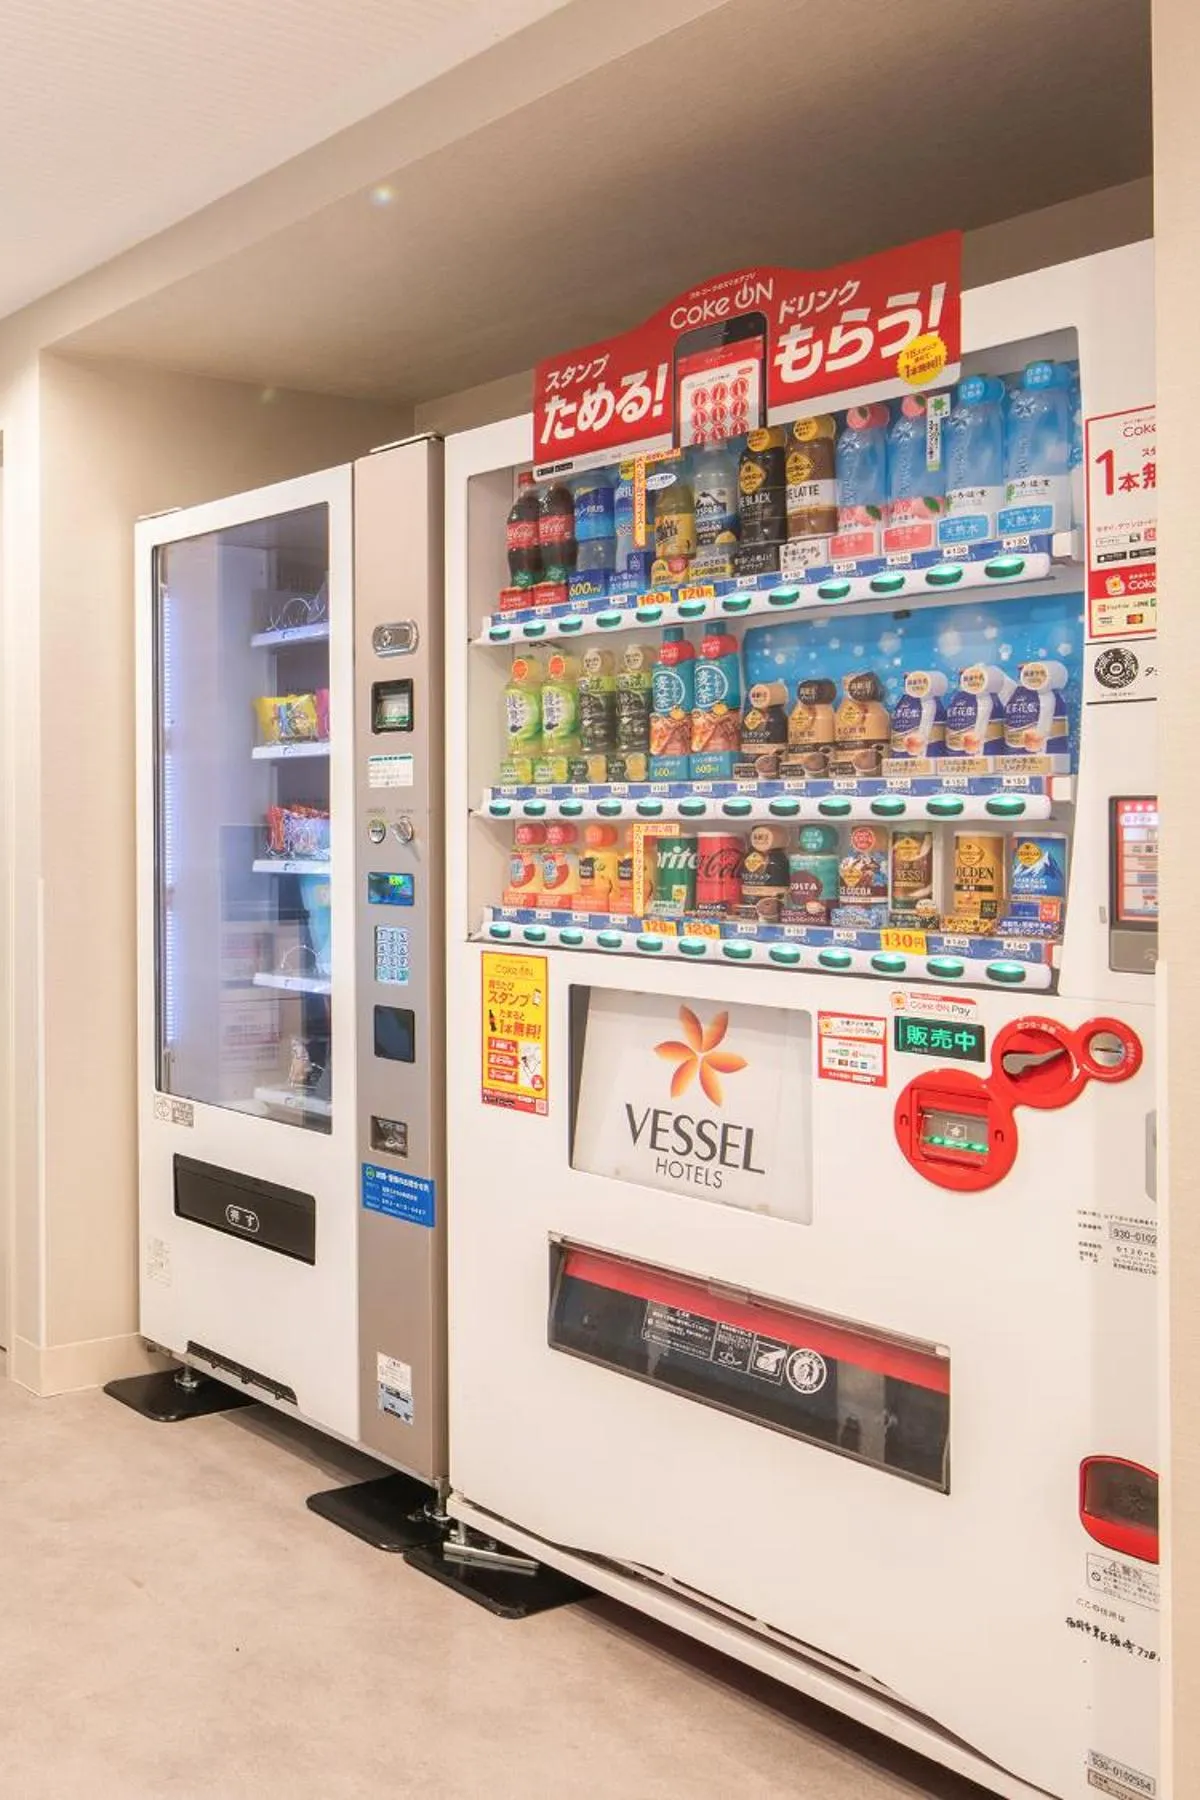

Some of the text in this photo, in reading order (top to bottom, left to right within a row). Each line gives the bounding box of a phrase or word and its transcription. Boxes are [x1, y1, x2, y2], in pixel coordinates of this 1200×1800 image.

[735, 277, 774, 309] ON
[778, 280, 861, 324] ドリンク
[545, 353, 610, 392] スタンプ
[795, 484, 820, 497] LATTE
[883, 931, 926, 950] 130円
[488, 990, 530, 1008] スタンプ
[951, 1004, 971, 1016] Pay
[906, 1025, 976, 1052] 販売中
[625, 1103, 766, 1175] VESSEL
[655, 1157, 723, 1189] HOTELS
